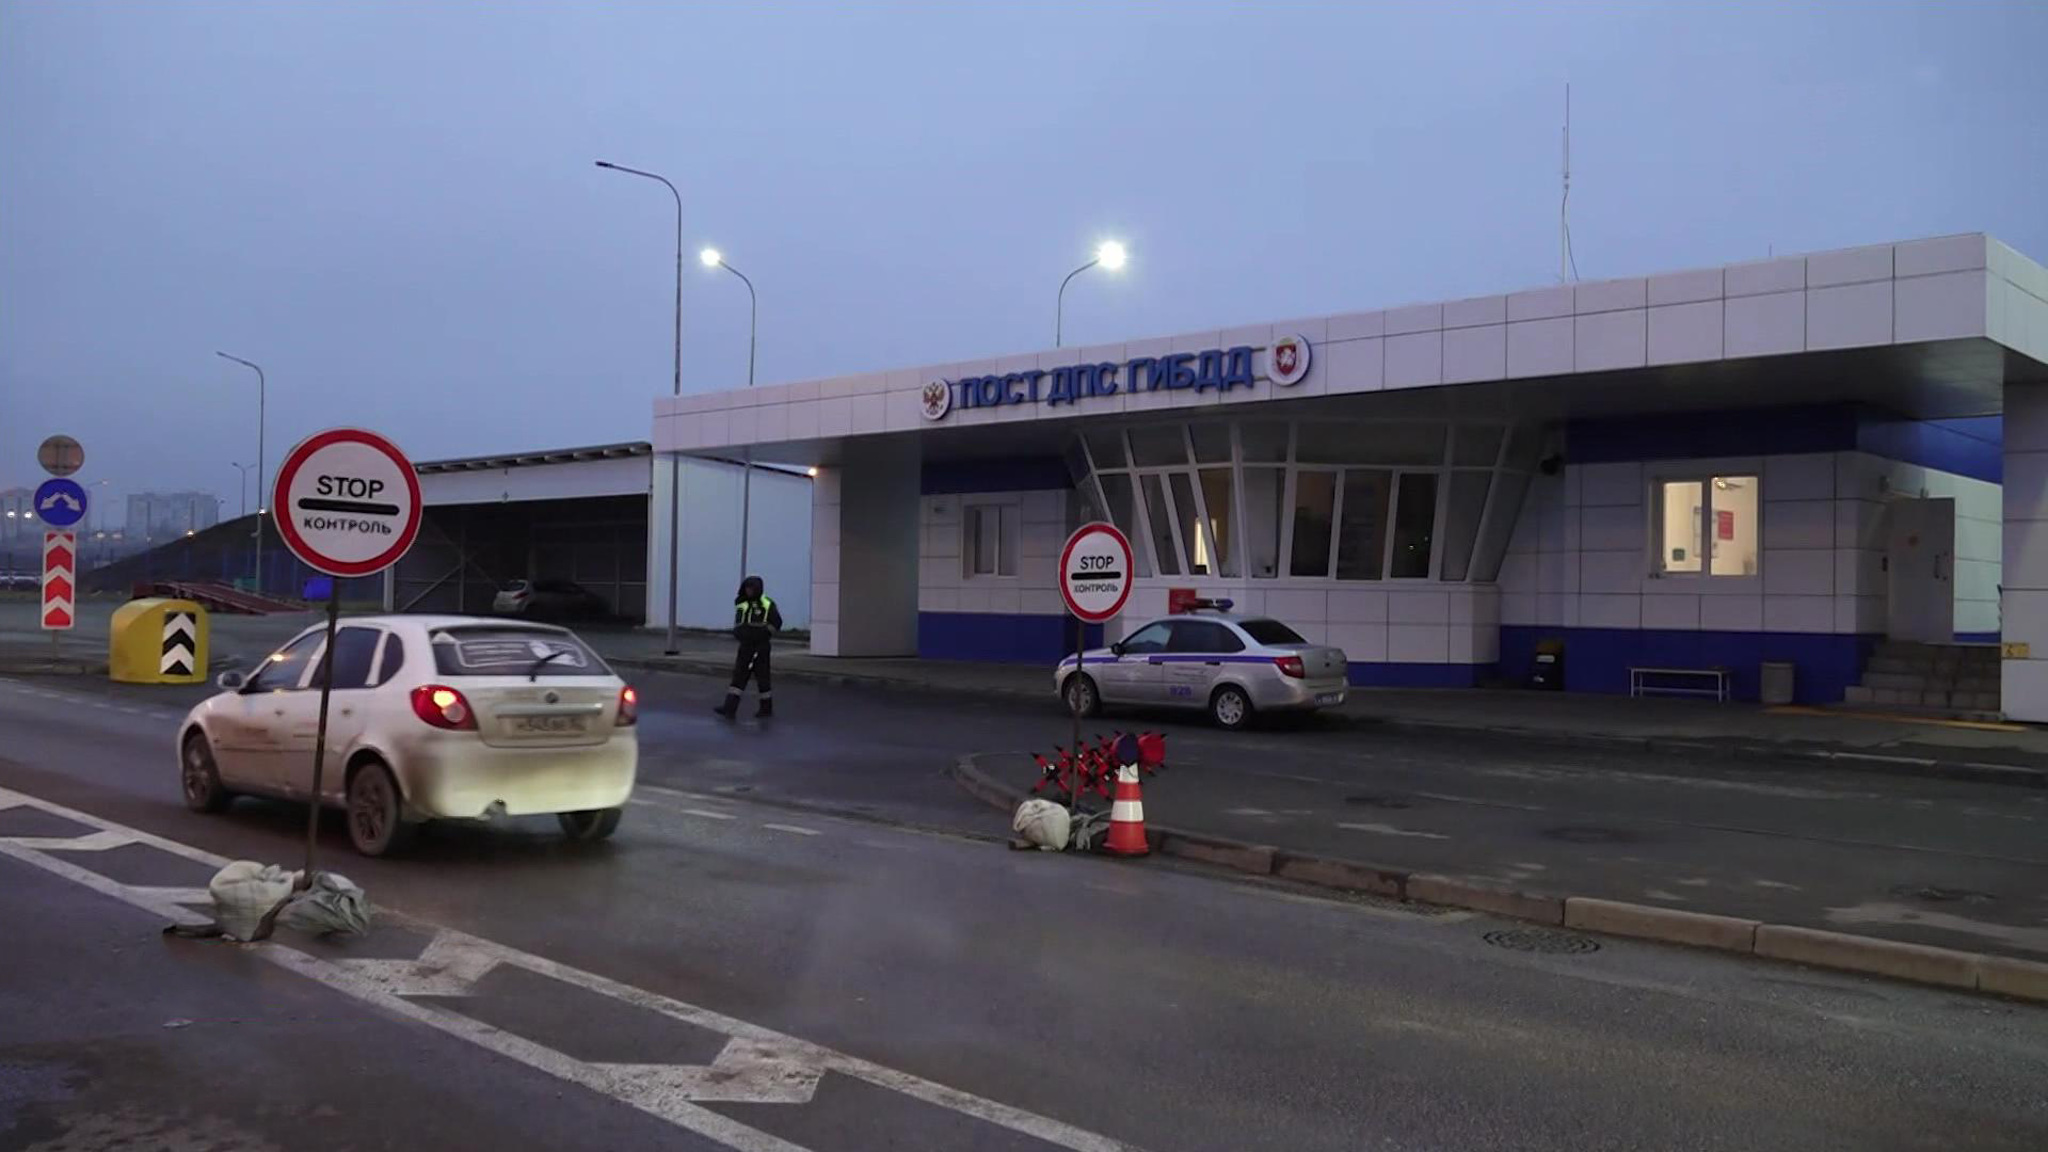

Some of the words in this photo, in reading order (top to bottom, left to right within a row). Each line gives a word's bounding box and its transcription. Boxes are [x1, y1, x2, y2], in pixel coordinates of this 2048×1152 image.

[960, 370, 1043, 408] ПОСТ
[1048, 363, 1118, 406] ДПС
[1127, 347, 1253, 393] ГИБДД
[317, 475, 384, 498] STOP
[304, 518, 391, 535] КОНТРОЛЬ
[1080, 556, 1114, 570] STOP
[1074, 583, 1118, 593] КОНТРОЛЬ
